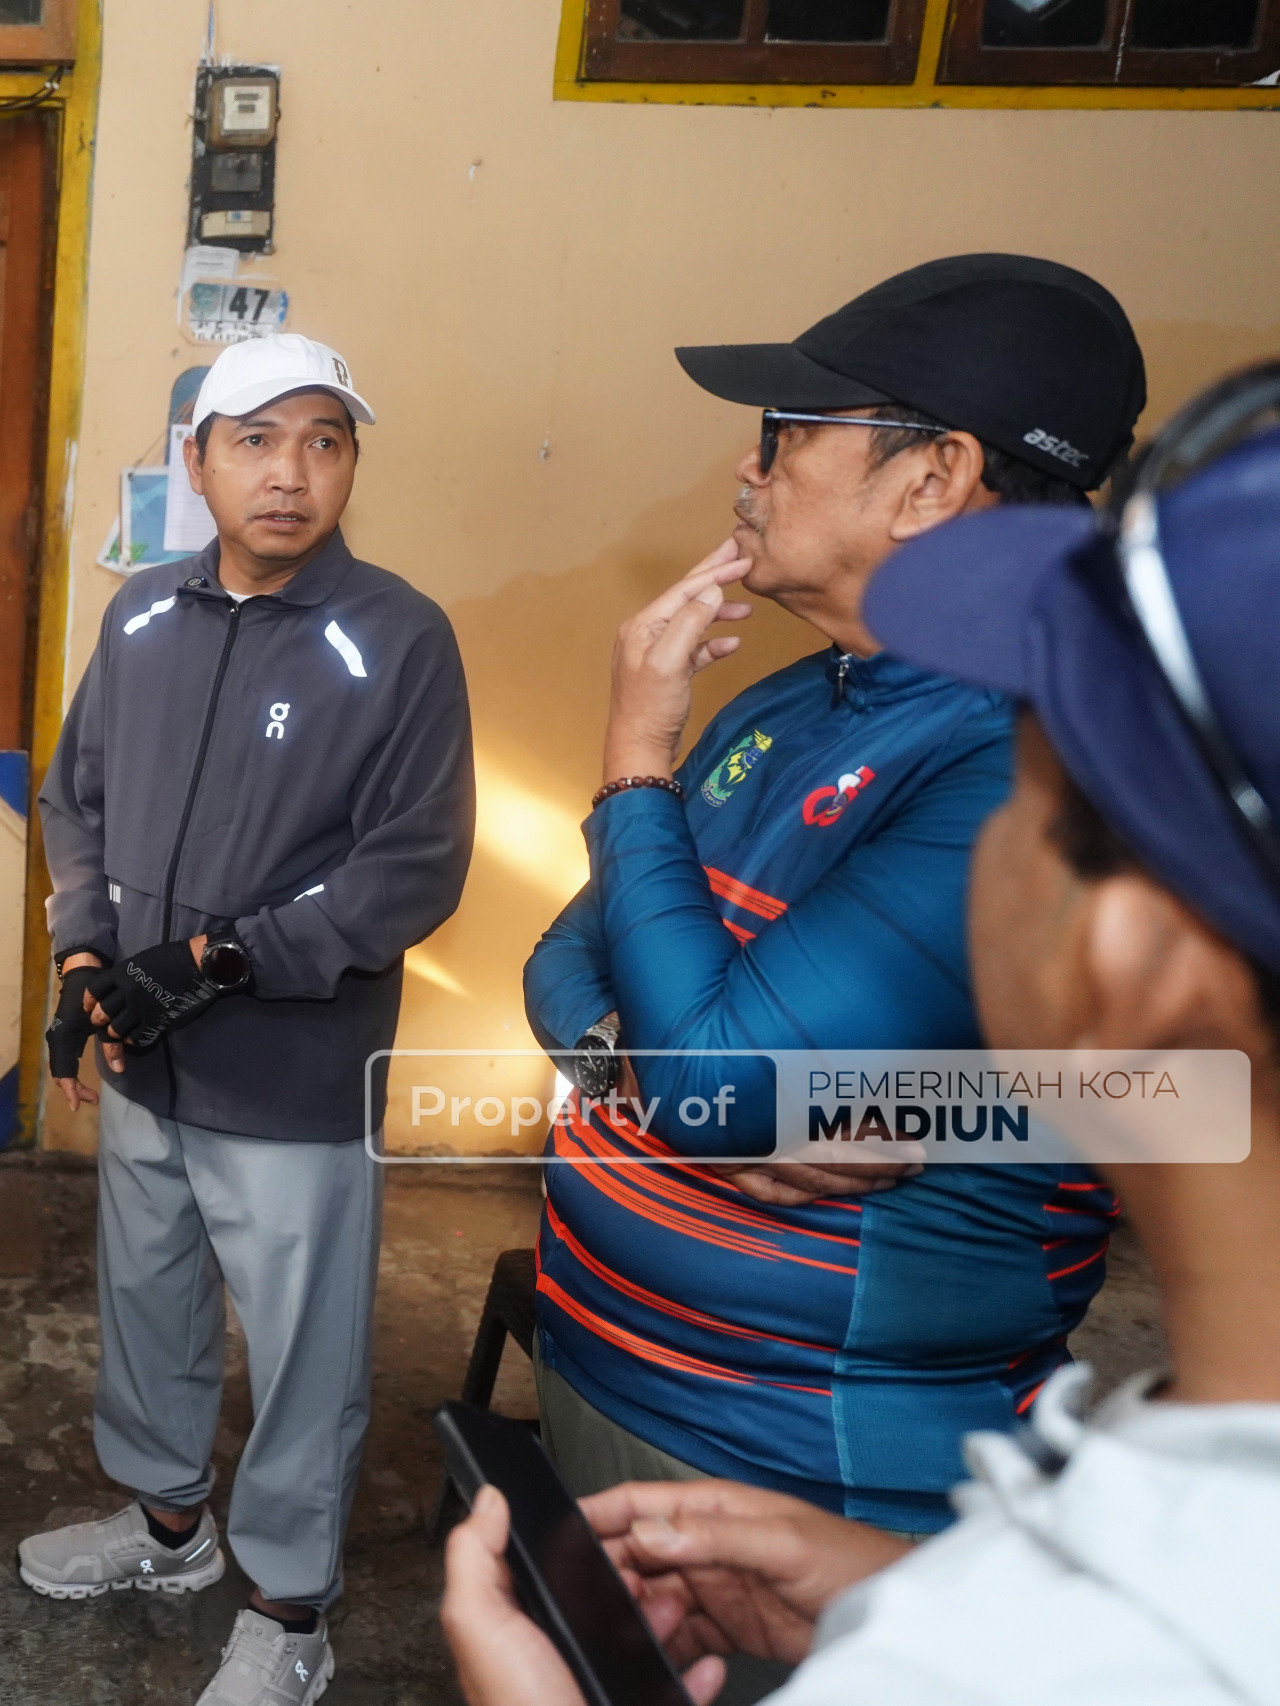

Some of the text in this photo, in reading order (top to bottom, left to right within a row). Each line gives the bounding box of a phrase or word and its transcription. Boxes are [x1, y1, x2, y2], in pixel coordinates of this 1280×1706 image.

[229, 287, 270, 325] 47
[1023, 428, 1089, 467] astec
[126, 962, 175, 1008] ZUNA
